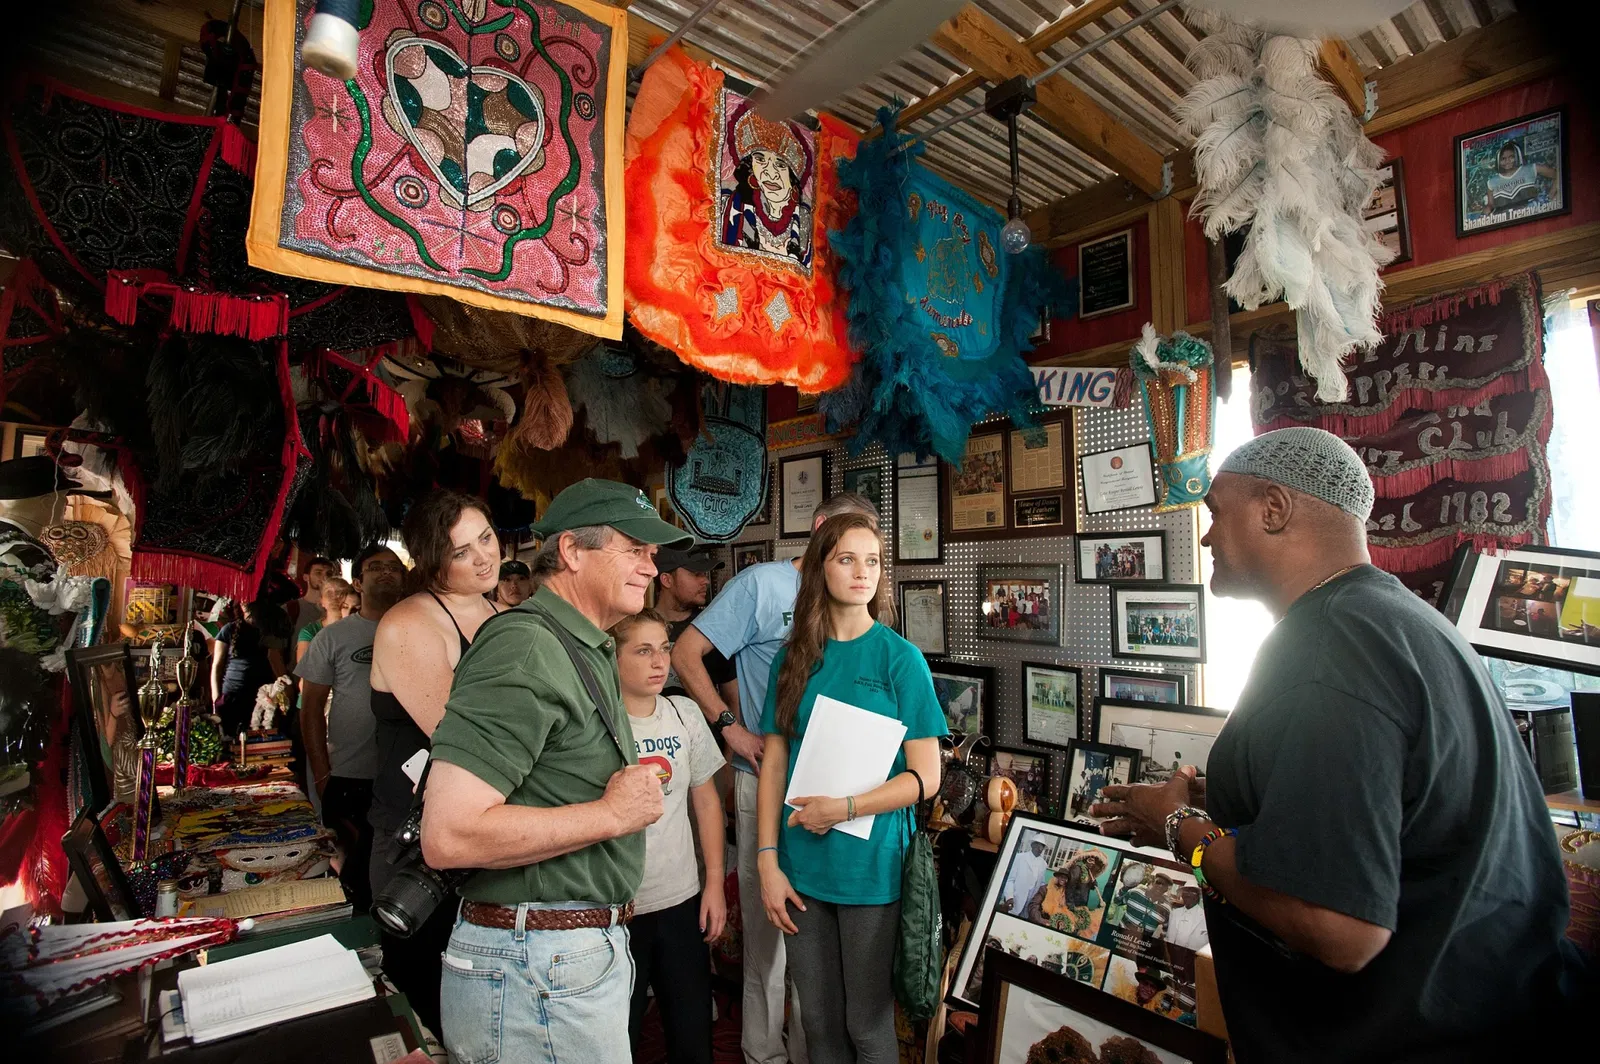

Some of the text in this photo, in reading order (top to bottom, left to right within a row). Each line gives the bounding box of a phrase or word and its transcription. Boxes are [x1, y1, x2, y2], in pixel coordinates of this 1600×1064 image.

[1037, 370, 1116, 403] KING
[774, 422, 804, 442] NICE
[1440, 491, 1512, 524] 1982
[1111, 930, 1152, 948] Ronald Lewis
